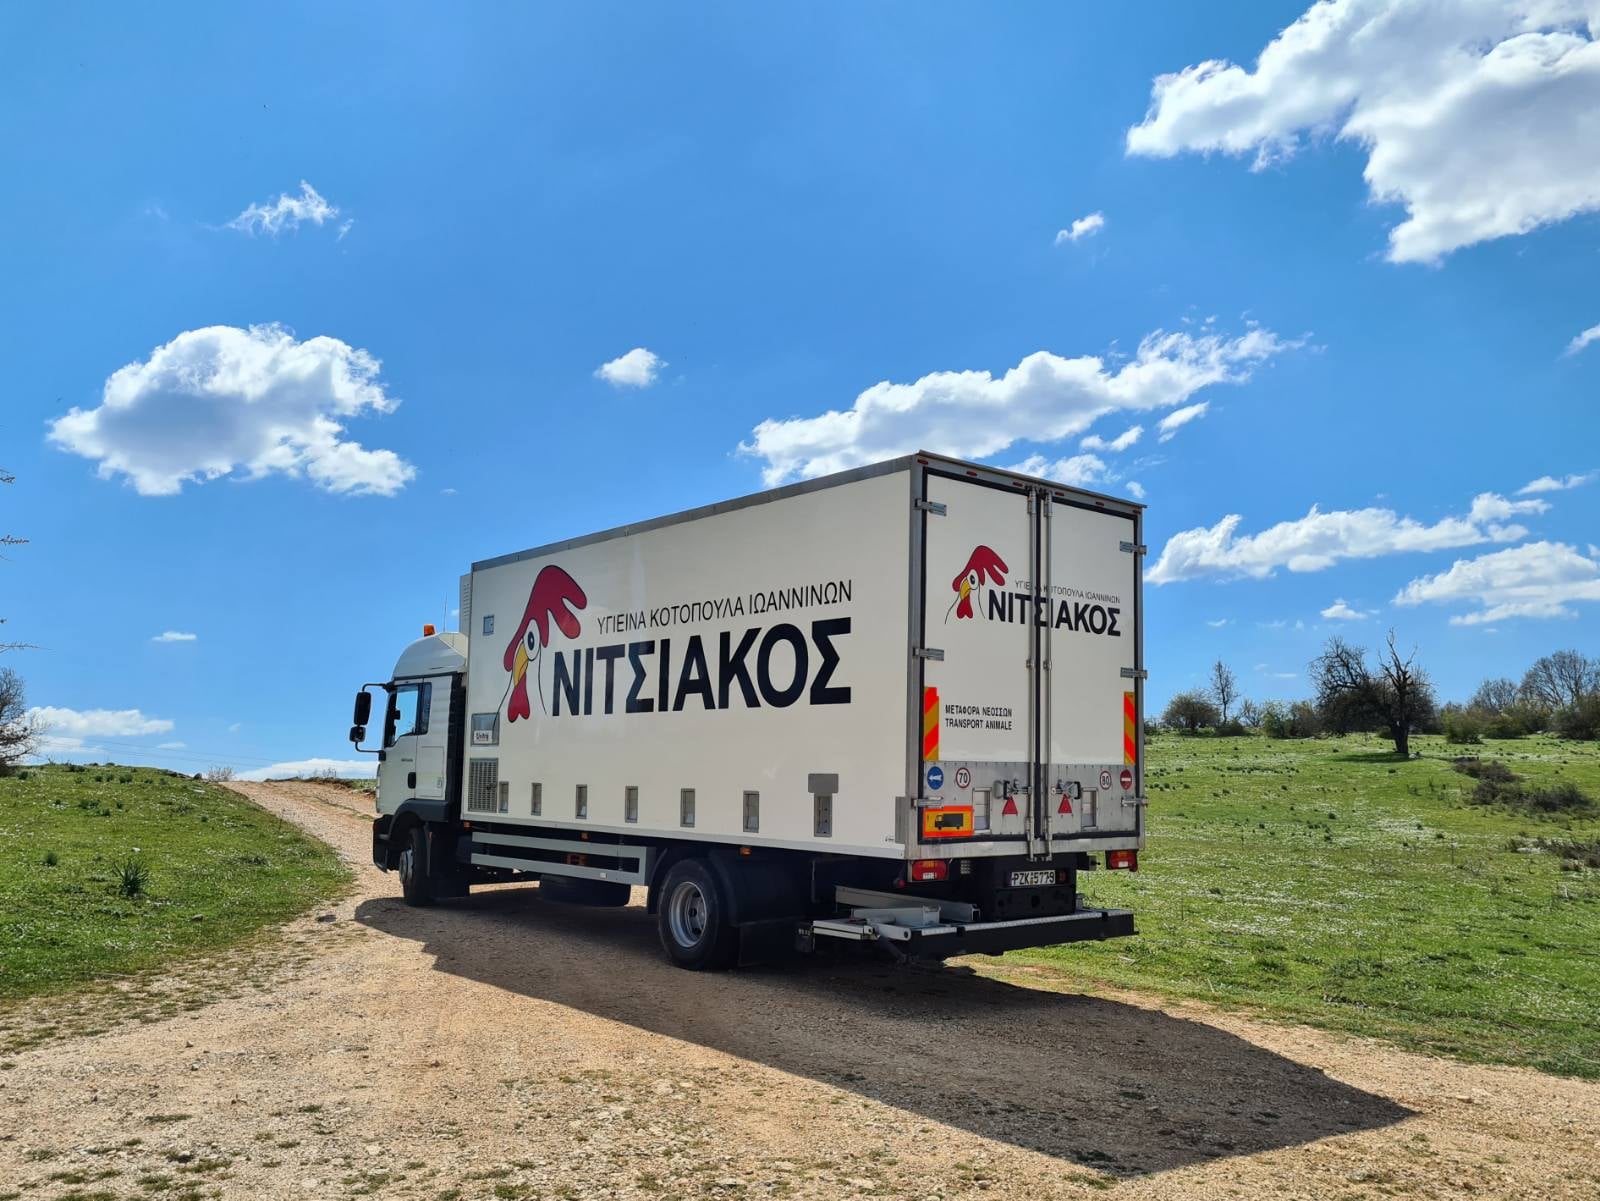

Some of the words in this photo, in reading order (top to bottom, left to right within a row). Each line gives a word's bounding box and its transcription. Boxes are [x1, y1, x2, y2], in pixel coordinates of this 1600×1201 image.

[597, 610, 647, 635] ΥΓΙΕΙΝΑ
[649, 596, 744, 628] ΚΟΤΟΠΟΥΛΑ
[748, 579, 852, 615] ΙΩΑΝΝΙΝΩΝ
[988, 588, 1121, 637] ΝΙΤΣΙΑΚΟΣ
[552, 616, 852, 717] ΝΙΤΣΙΑΚΟΣ
[945, 704, 980, 716] ΜΕΤΑΦΟΡΑ
[945, 718, 984, 729] TRANSPORT
[985, 720, 1012, 731] ANIMALE
[959, 772, 968, 784] 70
